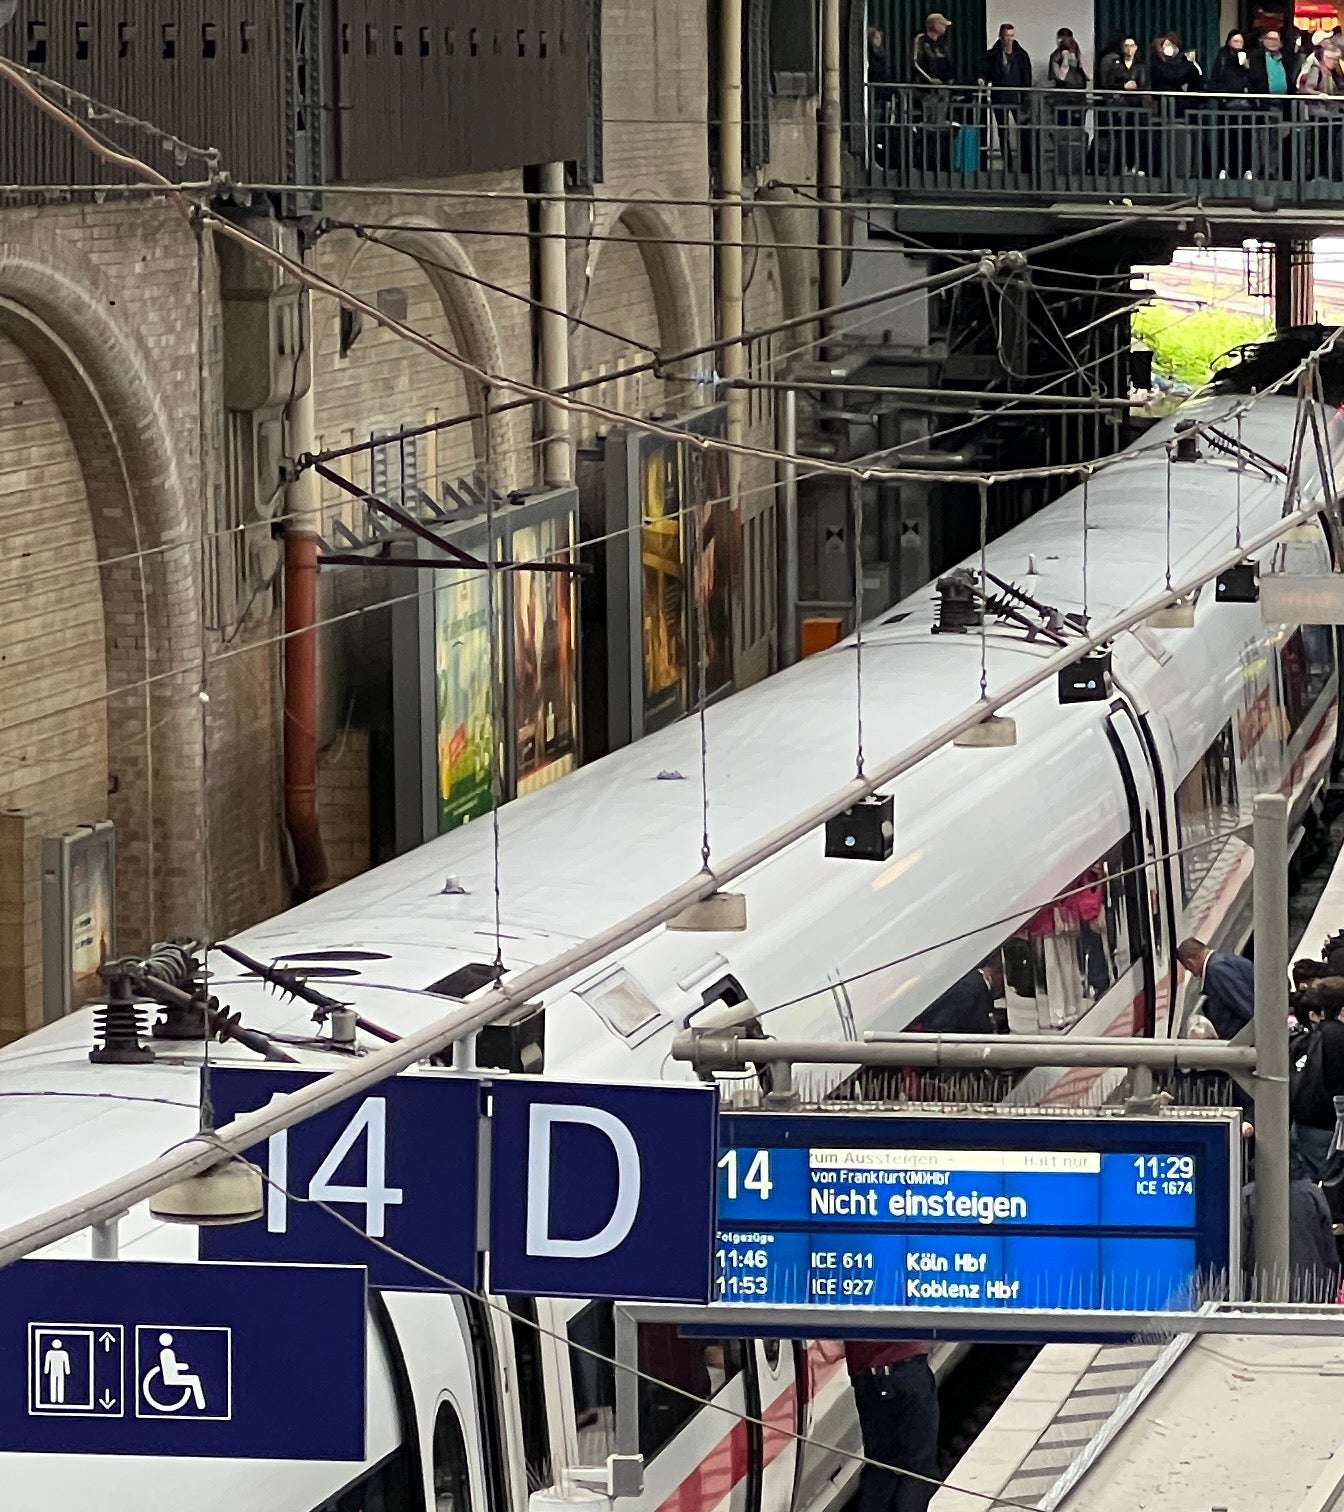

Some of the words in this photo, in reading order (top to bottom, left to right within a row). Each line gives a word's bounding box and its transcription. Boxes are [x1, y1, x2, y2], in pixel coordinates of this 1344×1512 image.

[526, 1102, 641, 1258] D
[717, 1149, 773, 1200] 14
[844, 1152, 939, 1167] Aussteigen
[1063, 1157, 1088, 1168] nur
[1133, 1156, 1194, 1179] 11:29
[811, 1172, 837, 1184] von
[839, 1170, 951, 1185] Frankfurt(M)Hbf
[1136, 1181, 1157, 1195] ICE
[1161, 1181, 1193, 1195] 1674
[811, 1188, 878, 1216] Nicht
[888, 1190, 1028, 1225] einsteigen
[716, 1249, 768, 1268] 11:46
[811, 1252, 837, 1269] ICE
[842, 1252, 874, 1269] 611
[906, 1252, 949, 1272] Köln
[954, 1253, 987, 1272] Hbf
[716, 1276, 768, 1295] 11:53
[811, 1279, 837, 1295] ICE
[842, 1279, 874, 1296] 927
[906, 1278, 980, 1299] Koblenz
[986, 1280, 1020, 1299] Hbf
